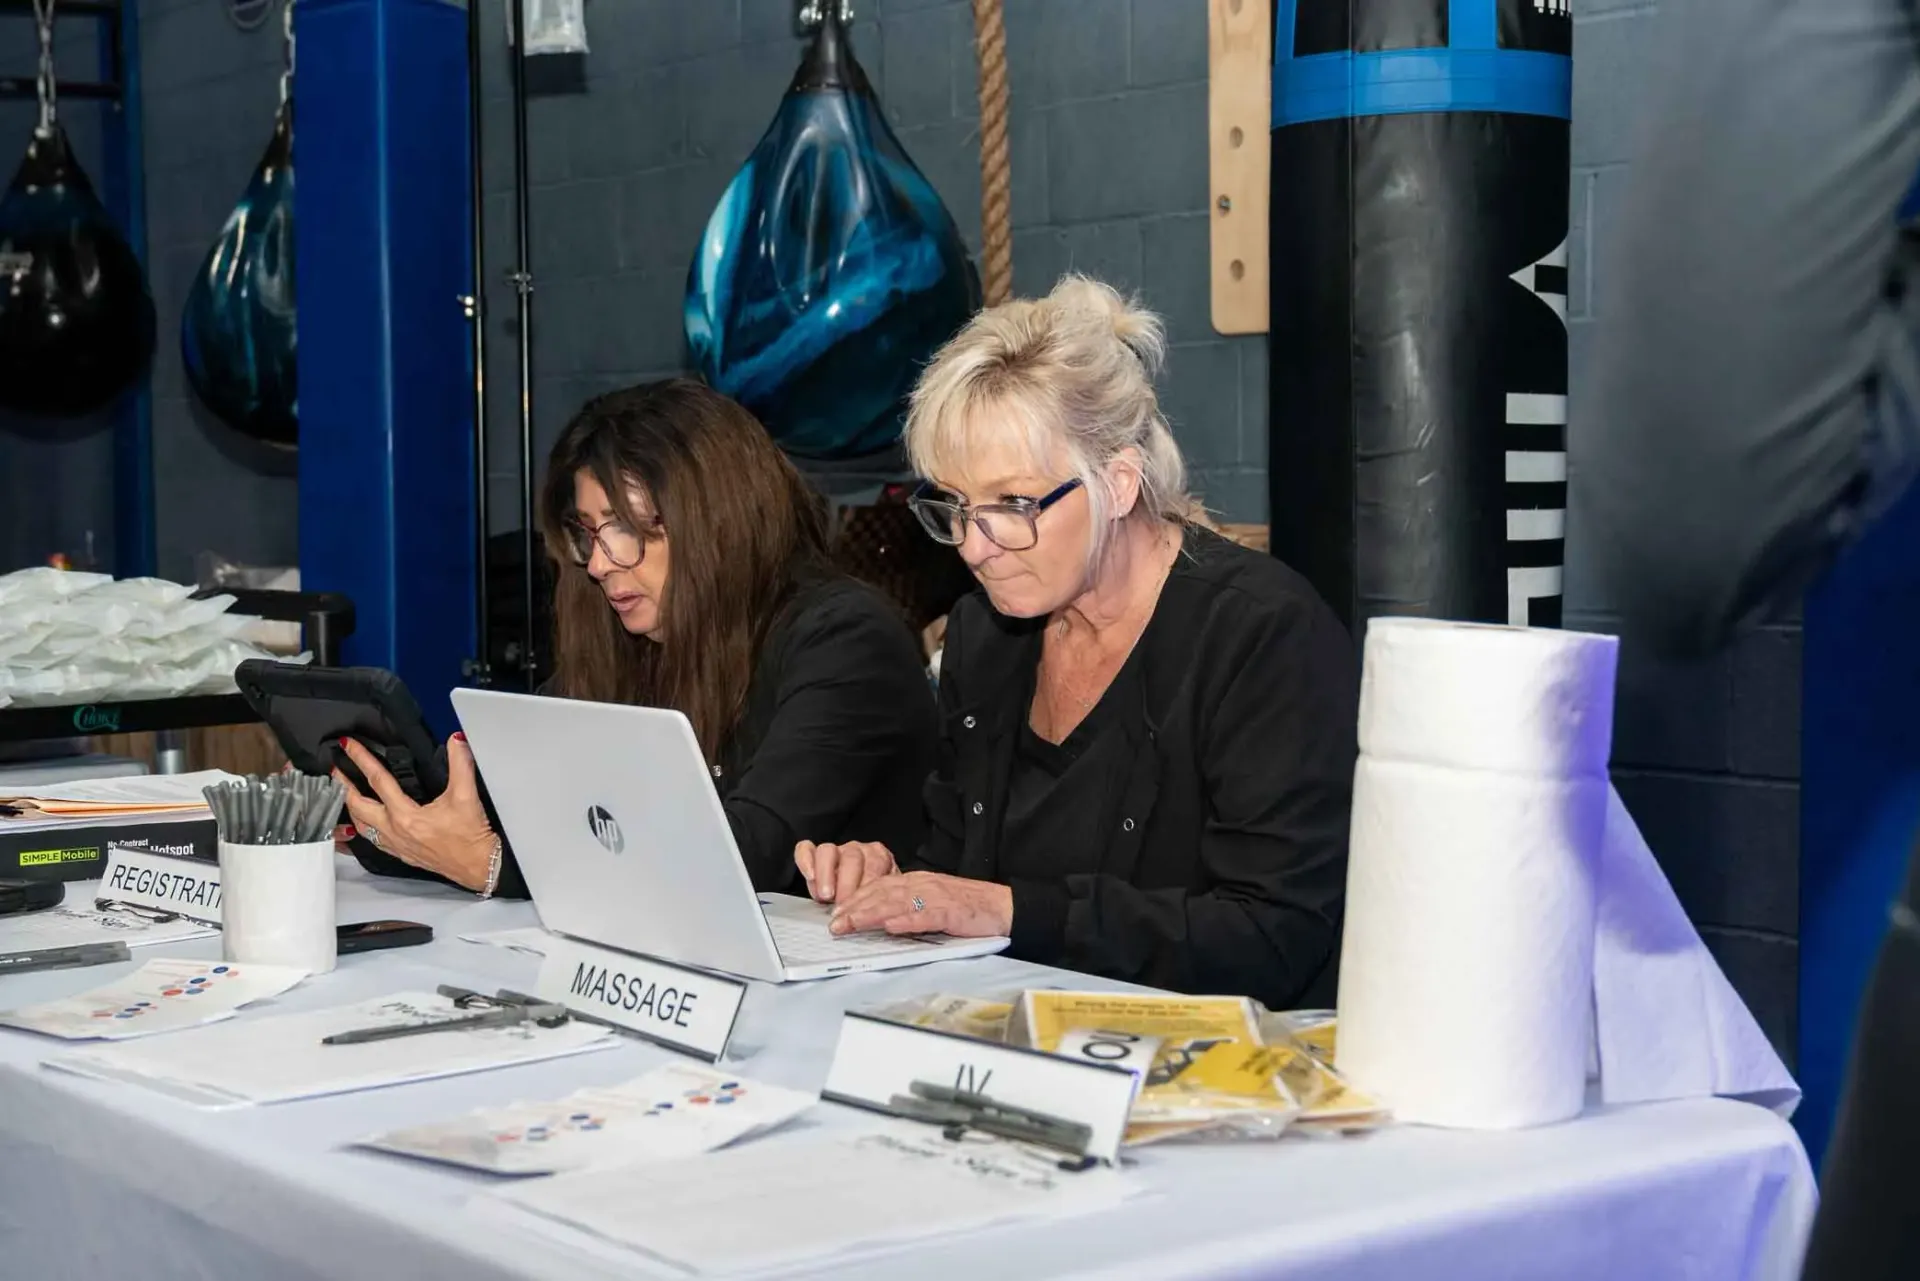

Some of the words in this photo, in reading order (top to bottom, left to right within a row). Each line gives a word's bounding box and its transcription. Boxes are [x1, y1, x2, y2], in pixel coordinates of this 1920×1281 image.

[22, 852, 60, 864] SIMPLE
[61, 850, 97, 861] Mobile
[570, 962, 698, 1028] MASSAGE
[955, 1063, 994, 1097] IV
